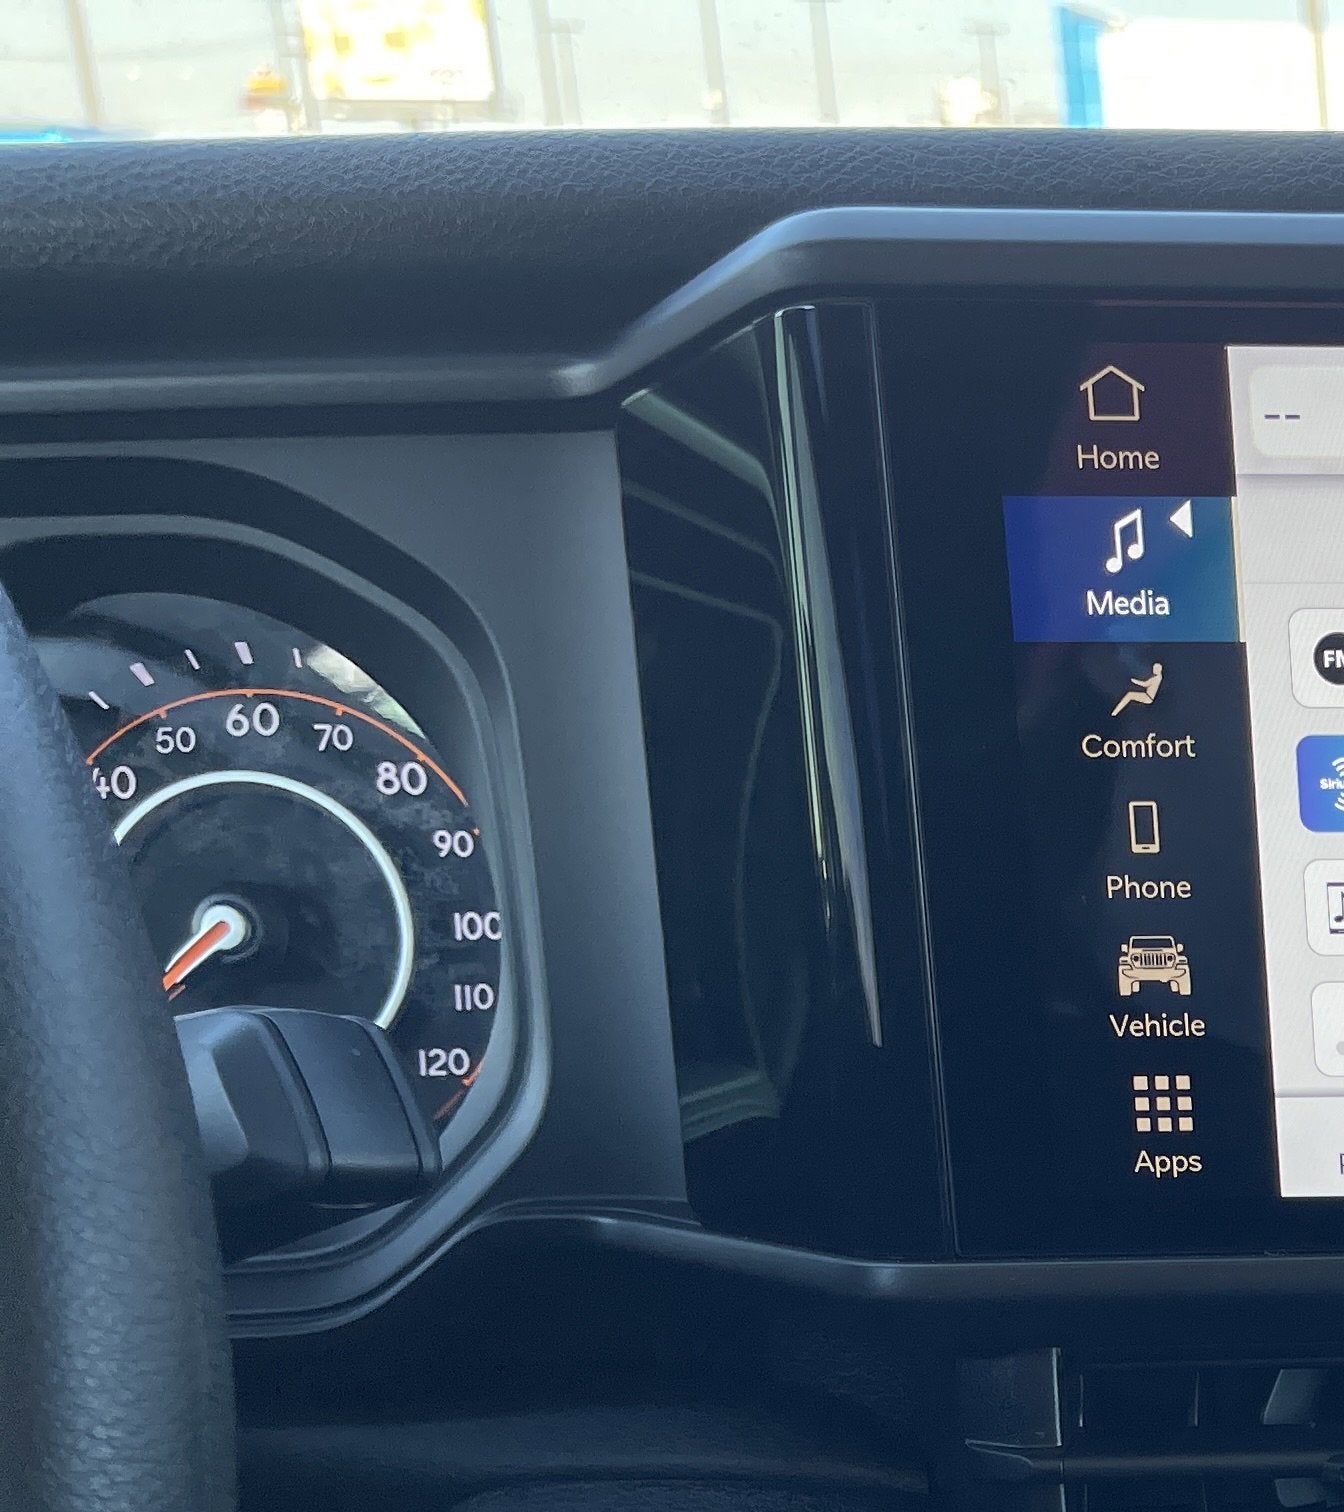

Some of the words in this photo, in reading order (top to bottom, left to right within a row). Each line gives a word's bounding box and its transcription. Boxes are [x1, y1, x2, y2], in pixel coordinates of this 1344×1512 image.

[1076, 444, 1160, 471] Home
[1086, 590, 1170, 617] Media
[225, 702, 281, 738] 60
[154, 725, 196, 754] 50
[313, 723, 354, 752] 70
[1080, 734, 1197, 760] Comfort
[375, 760, 428, 796] 80
[432, 829, 475, 858] 90
[1106, 874, 1192, 900] Phone
[453, 910, 502, 940] 100
[454, 982, 495, 1011] 110
[1109, 1013, 1206, 1039] Vehicle
[417, 1047, 471, 1078] 120
[1134, 1150, 1203, 1178] Apps
